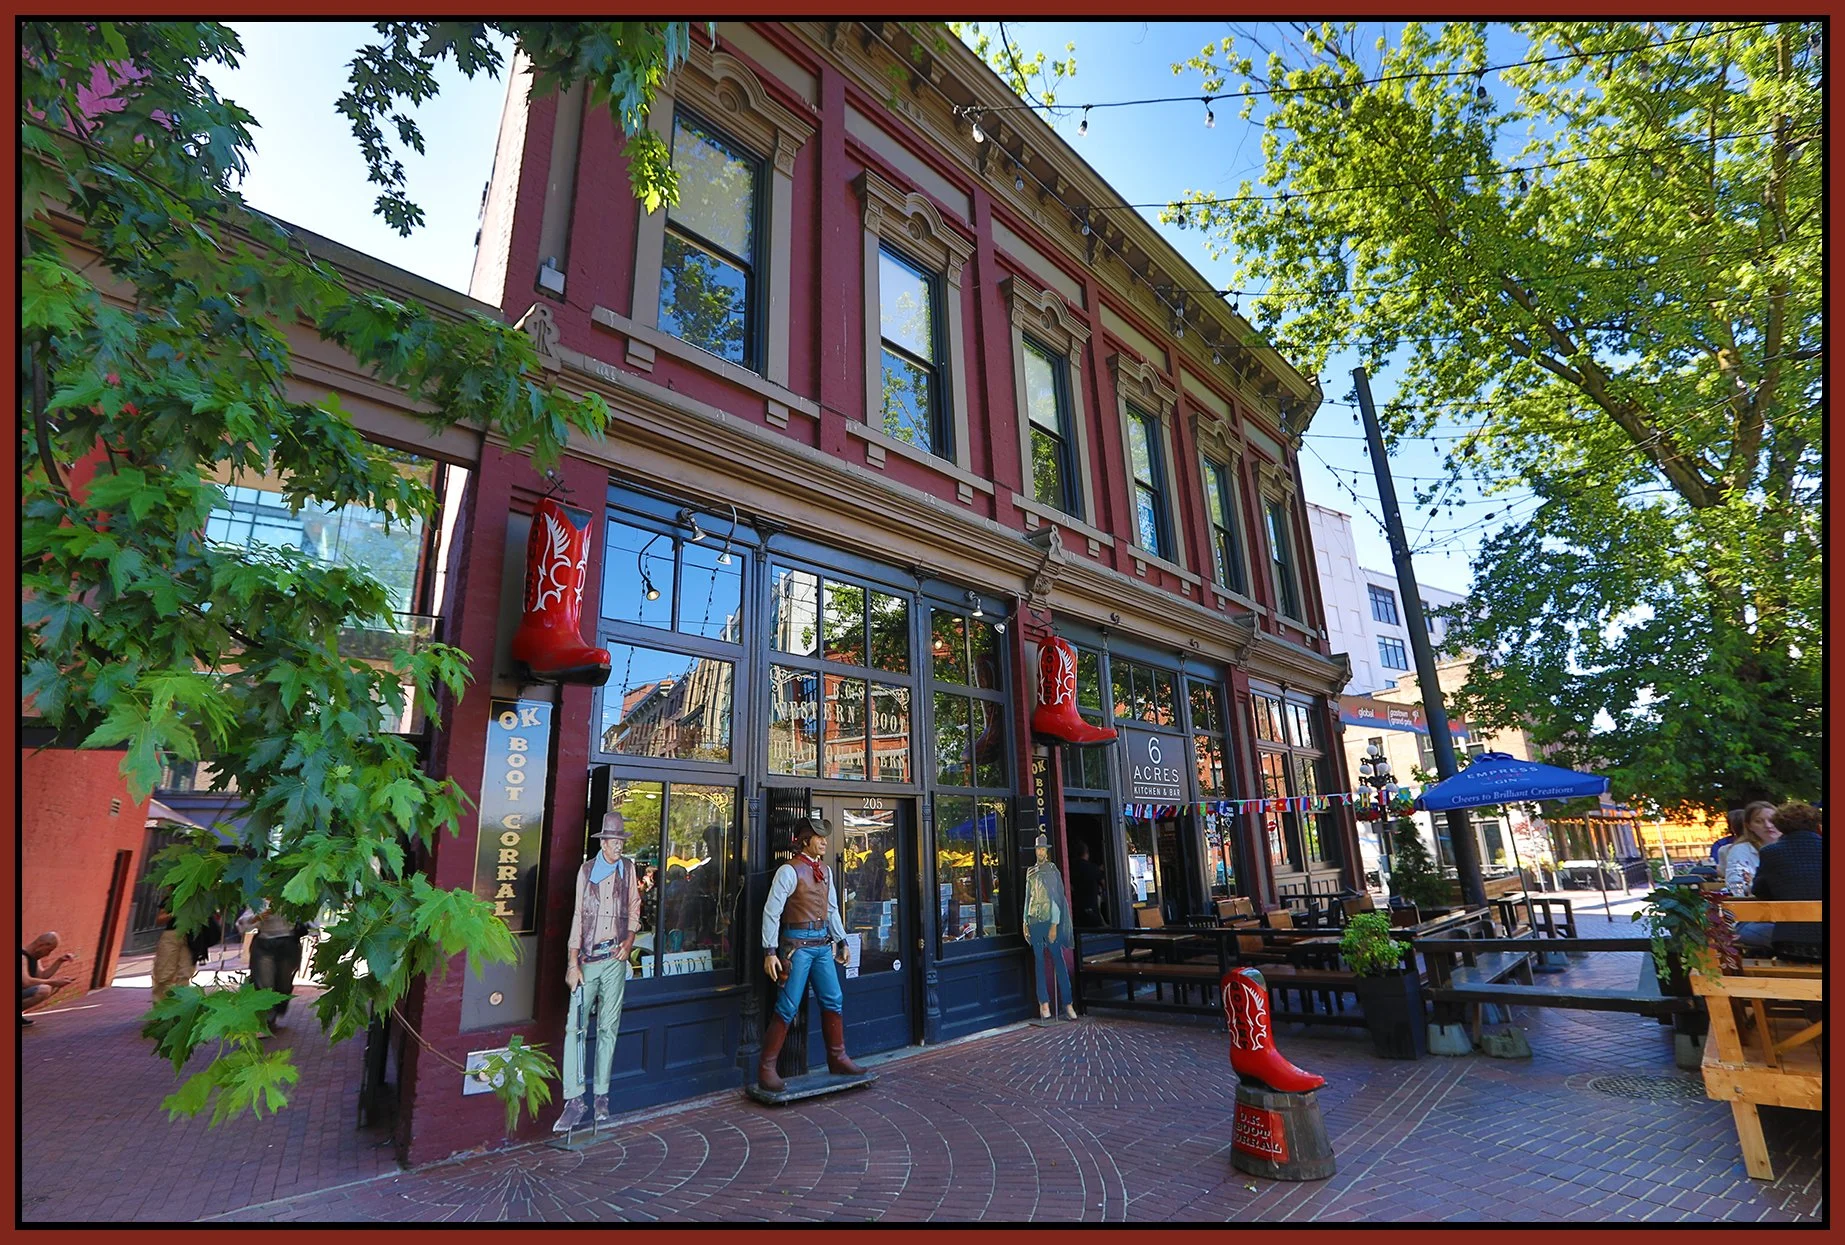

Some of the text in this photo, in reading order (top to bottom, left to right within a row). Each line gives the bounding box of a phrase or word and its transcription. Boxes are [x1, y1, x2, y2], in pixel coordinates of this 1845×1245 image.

[774, 701, 855, 724] WESTERN
[1358, 707, 1375, 719] global
[1390, 709, 1408, 717] gastown
[871, 710, 906, 734] BOOT
[1148, 736, 1162, 765] 6
[1032, 760, 1046, 775] OK
[1133, 765, 1179, 783] ACRES
[1467, 766, 1539, 779] EMPRESS
[1495, 777, 1518, 785] GIN
[1036, 778, 1045, 816] BOOT
[1133, 787, 1180, 797] KITCHEN & BAR
[1452, 786, 1574, 805] Cheers to Brilliant Creations
[494, 707, 541, 916] OK BOOT CORRAL
[863, 797, 882, 809] 205
[1233, 1133, 1283, 1154] ORRAL
